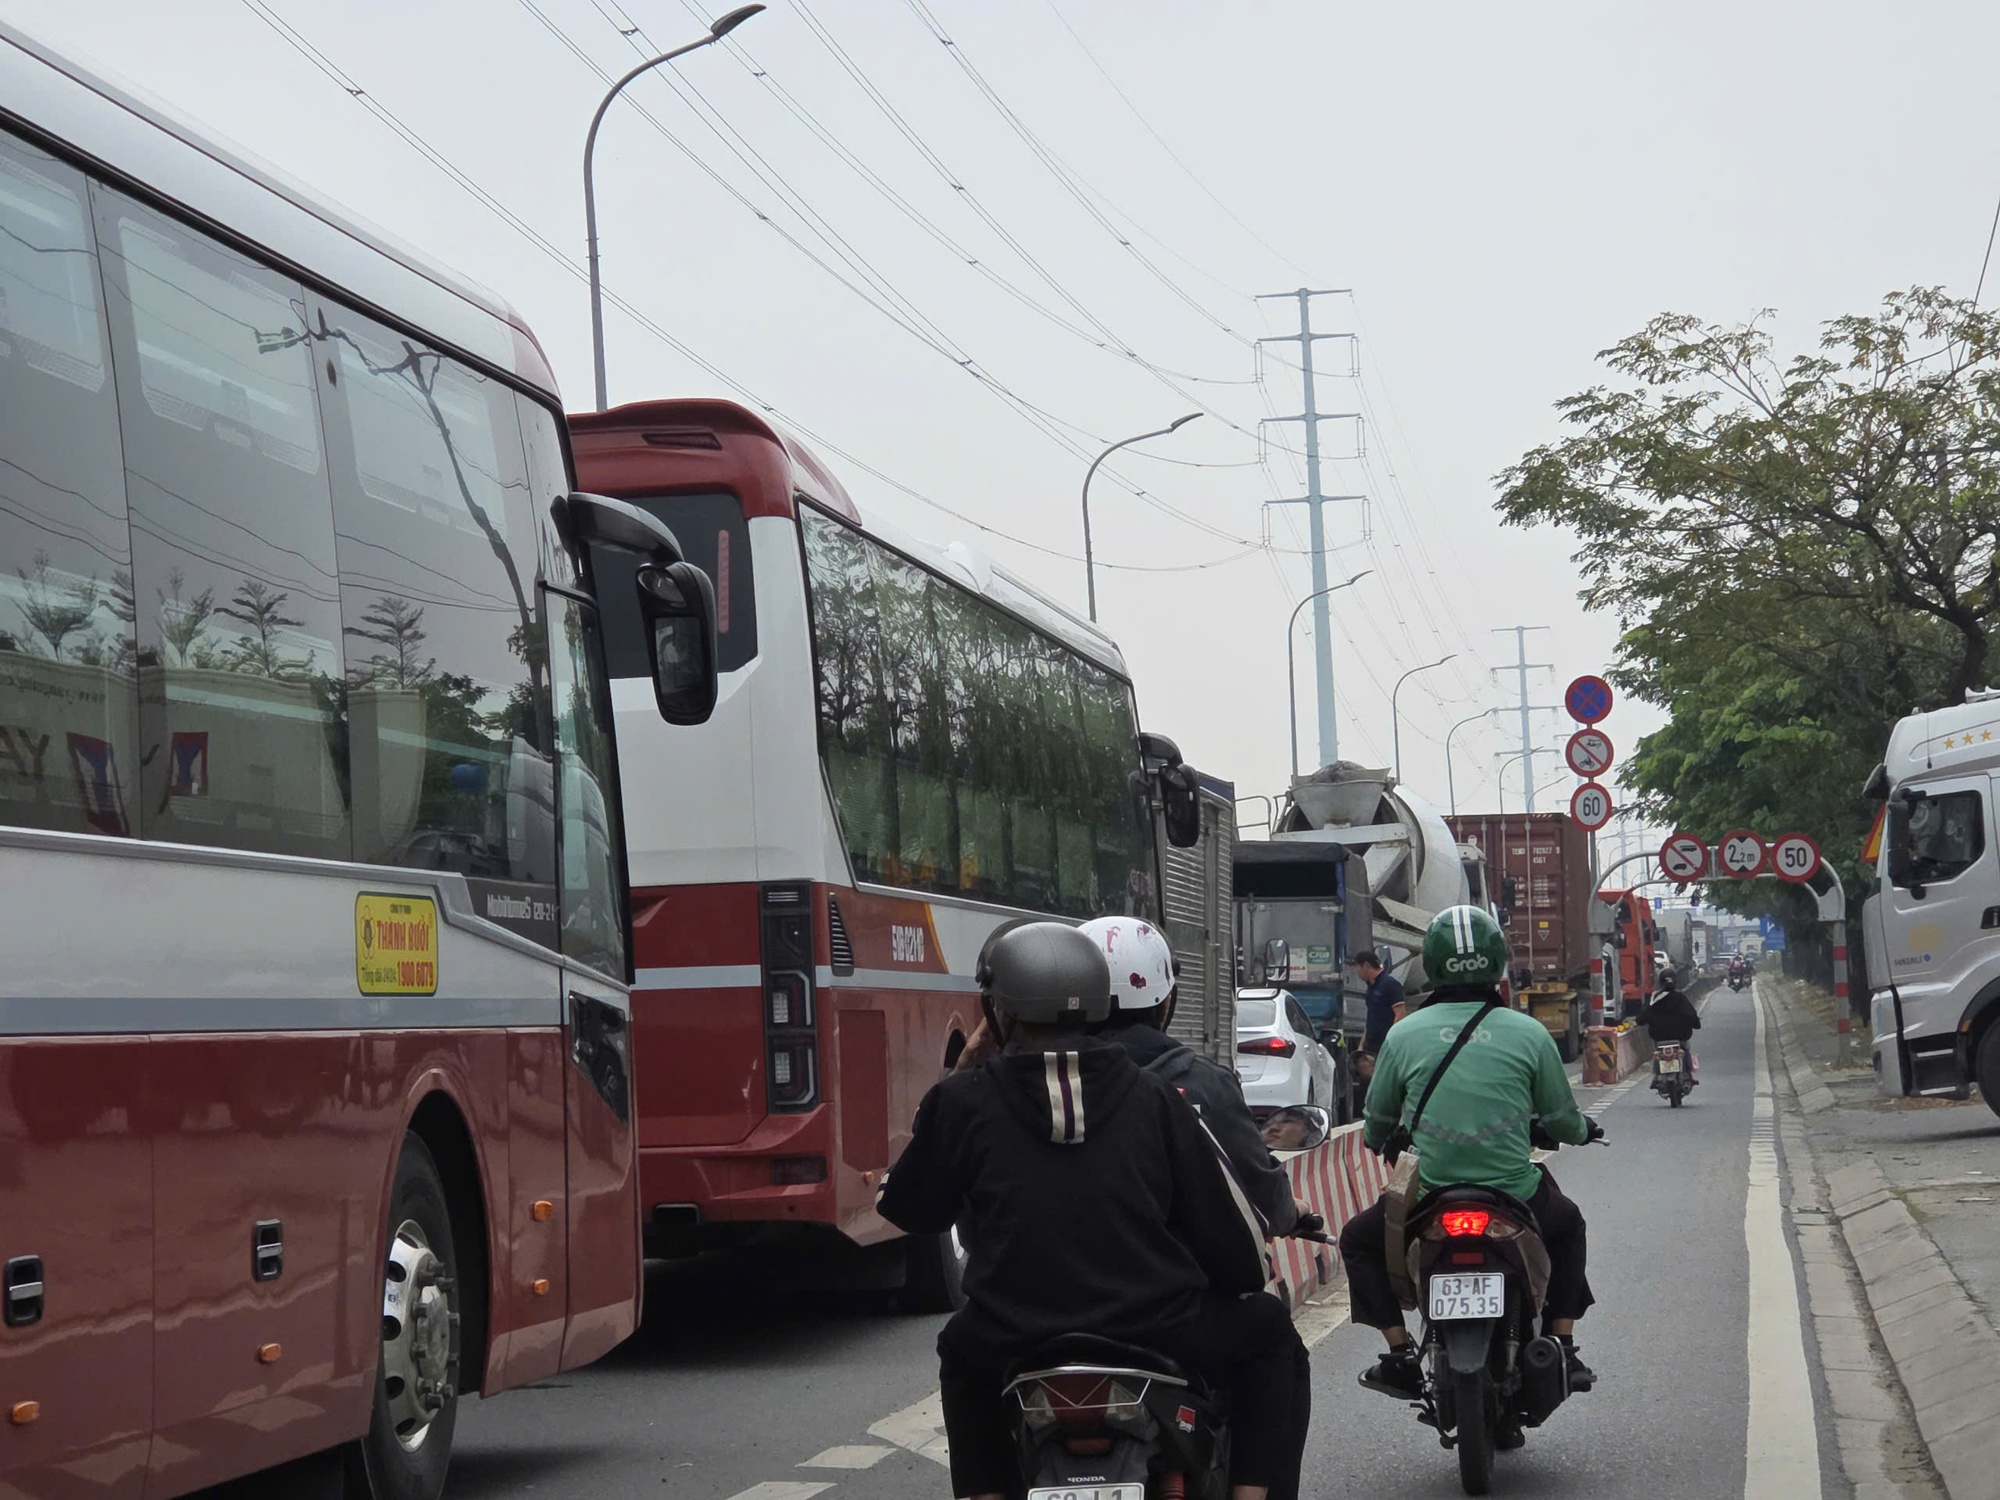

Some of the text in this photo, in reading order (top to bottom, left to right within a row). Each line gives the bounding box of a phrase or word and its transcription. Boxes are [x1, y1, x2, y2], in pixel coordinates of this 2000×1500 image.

[1583, 796, 1600, 817] 60
[1784, 847, 1807, 868] 50
[1446, 954, 1489, 973] Grab
[397, 961, 415, 987] 1900
[1442, 1277, 1492, 1296] 63-AF
[1435, 1296, 1499, 1316] 075.35
[1067, 1475, 1106, 1483] HONDA
